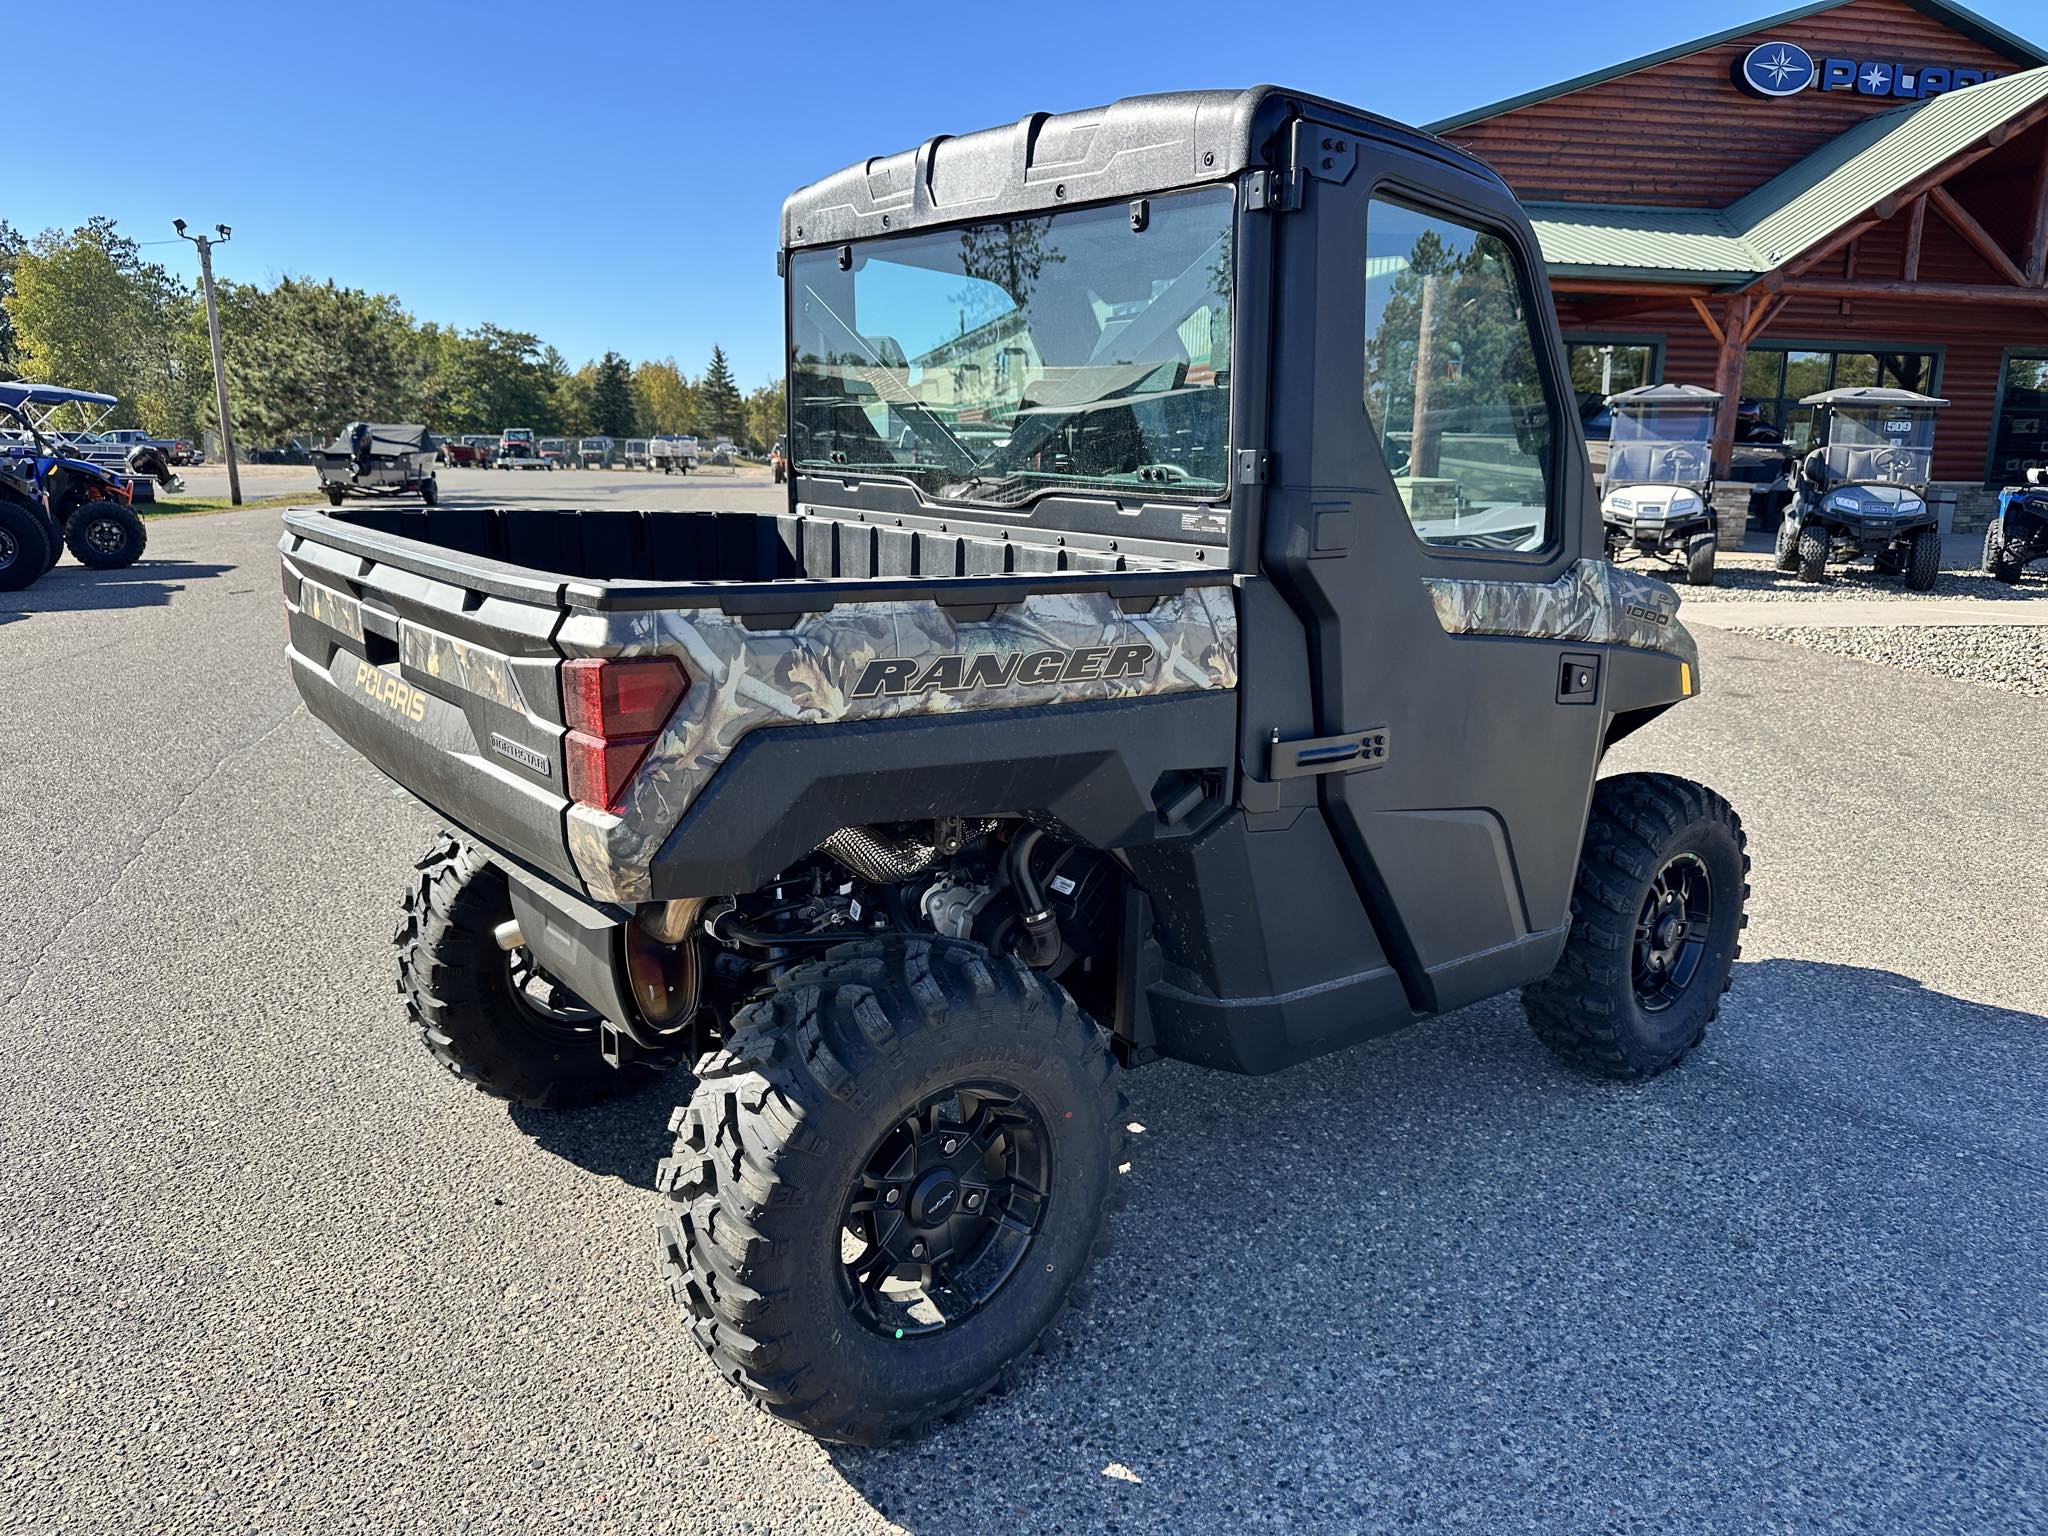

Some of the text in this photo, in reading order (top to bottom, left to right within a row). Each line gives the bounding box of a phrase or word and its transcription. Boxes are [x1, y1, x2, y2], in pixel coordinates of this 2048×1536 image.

[1823, 58, 1996, 98] POLAR
[1625, 605, 1669, 628] 1000
[355, 661, 426, 722] POLARIS
[849, 644, 1154, 699] RANGER
